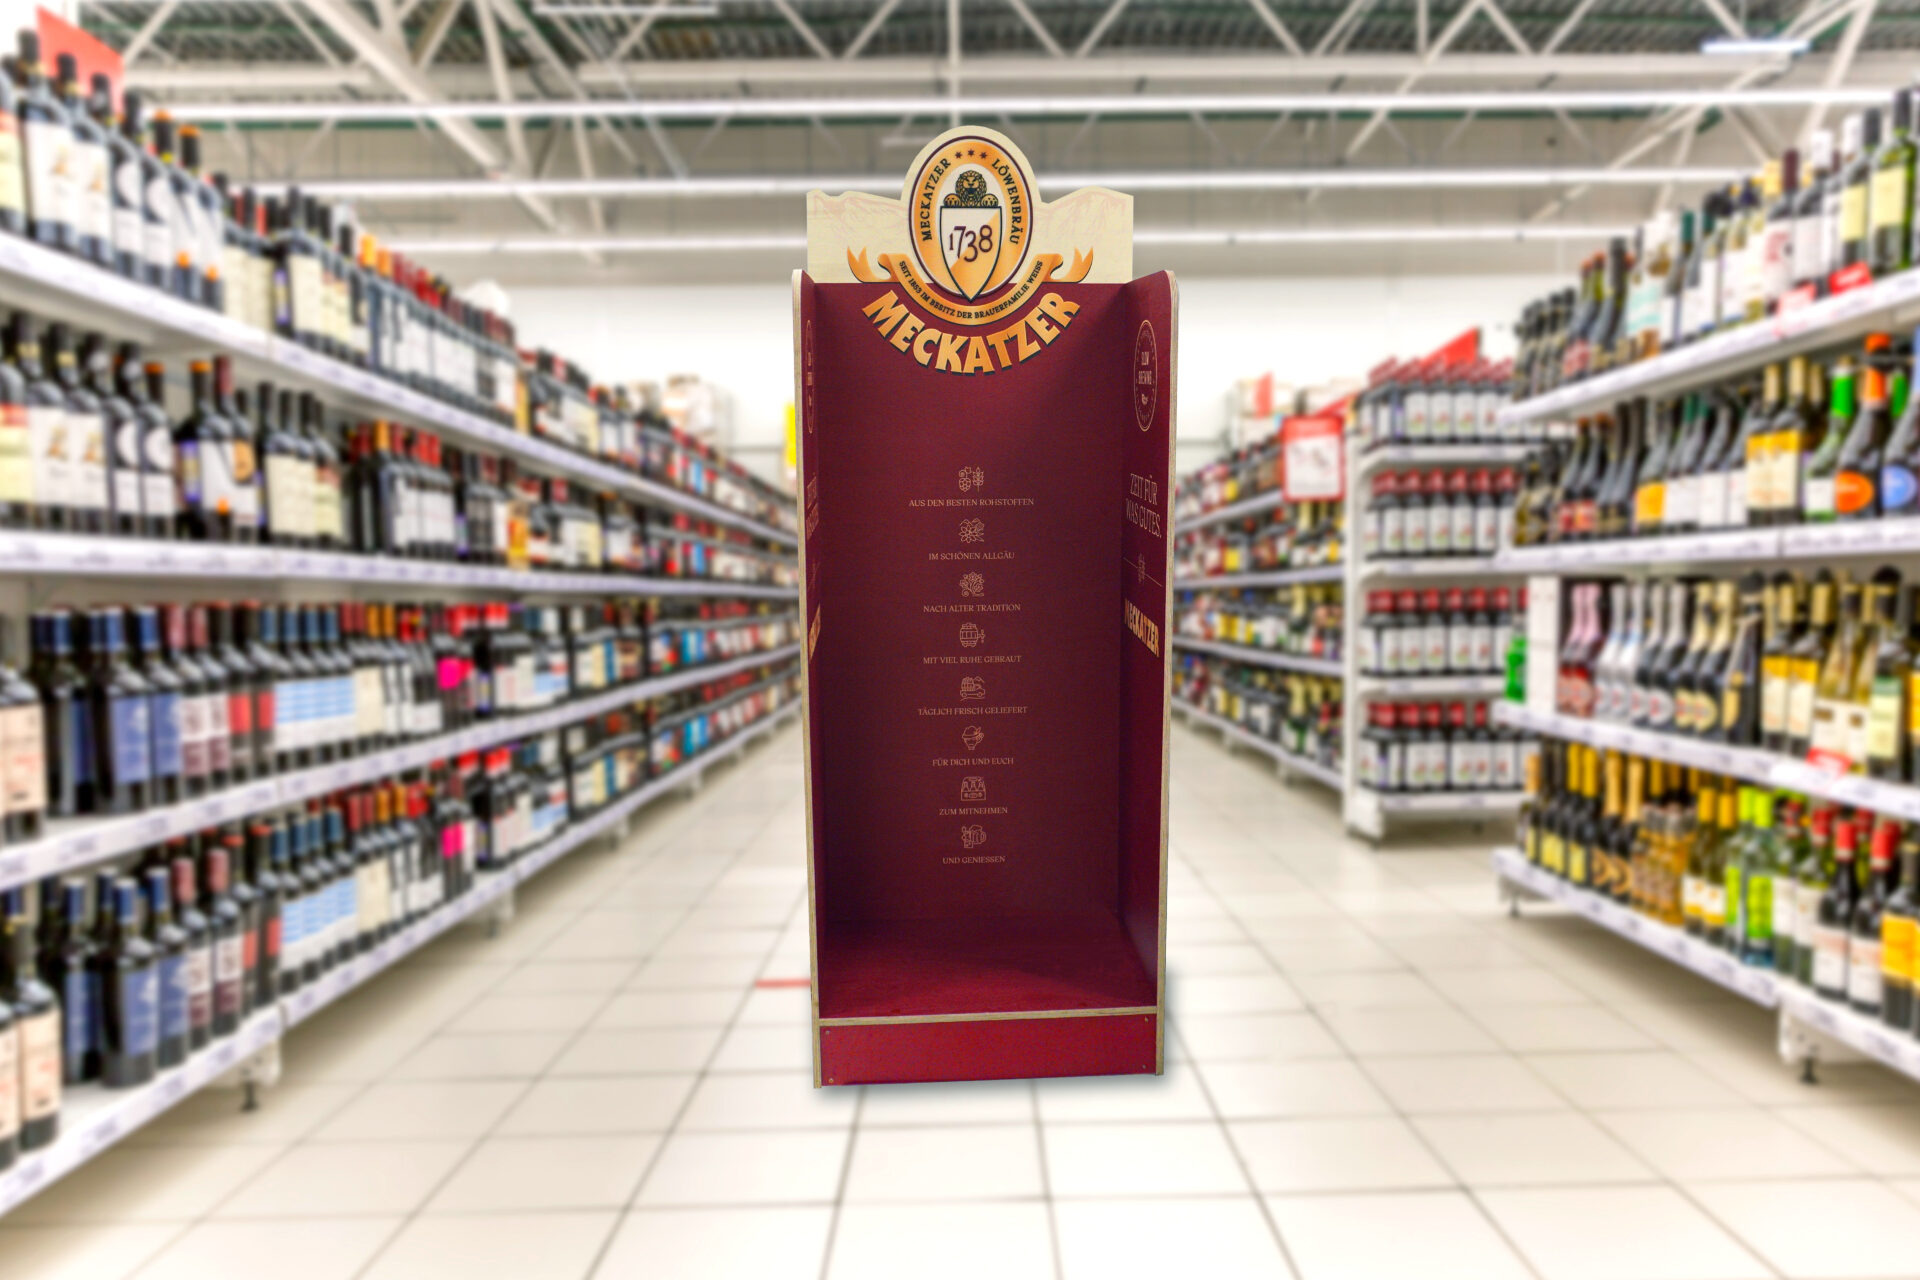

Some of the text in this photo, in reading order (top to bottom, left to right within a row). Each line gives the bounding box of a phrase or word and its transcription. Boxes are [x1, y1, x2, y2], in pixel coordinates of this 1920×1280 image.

[920, 158, 1023, 245] MECKATZER LÖWENBRÄU
[949, 224, 993, 262] 1738
[899, 260, 912, 278] SEIT
[920, 291, 931, 303] IM
[929, 299, 956, 317] BESITZ
[956, 311, 973, 319] DER
[974, 283, 1030, 319] BRAUERFAMILIE
[1026, 260, 1043, 284] WEISS
[862, 290, 1081, 375] MECKATZER
[1130, 473, 1158, 505] ZEIT FÜR
[908, 498, 1035, 507] AUS DEN BESTEN ROHSTOFFEN
[1126, 498, 1162, 539] WAS GUTES.
[928, 551, 1015, 561] IM SCHÖNEN ALLGÄU
[923, 603, 1021, 613] NACH ALTER TRADITION
[1124, 599, 1160, 658] MECKATZER
[923, 655, 1022, 664] MIT VIEL RUHE GEBRAUT
[918, 706, 1028, 716] TÄGLICH FRISCH GELIEFERT
[932, 757, 1014, 766] FÜR DICH UND EUCH
[939, 807, 1008, 816] ZUM MITNEHMEN
[942, 856, 1006, 865] UND GENIESSEN
